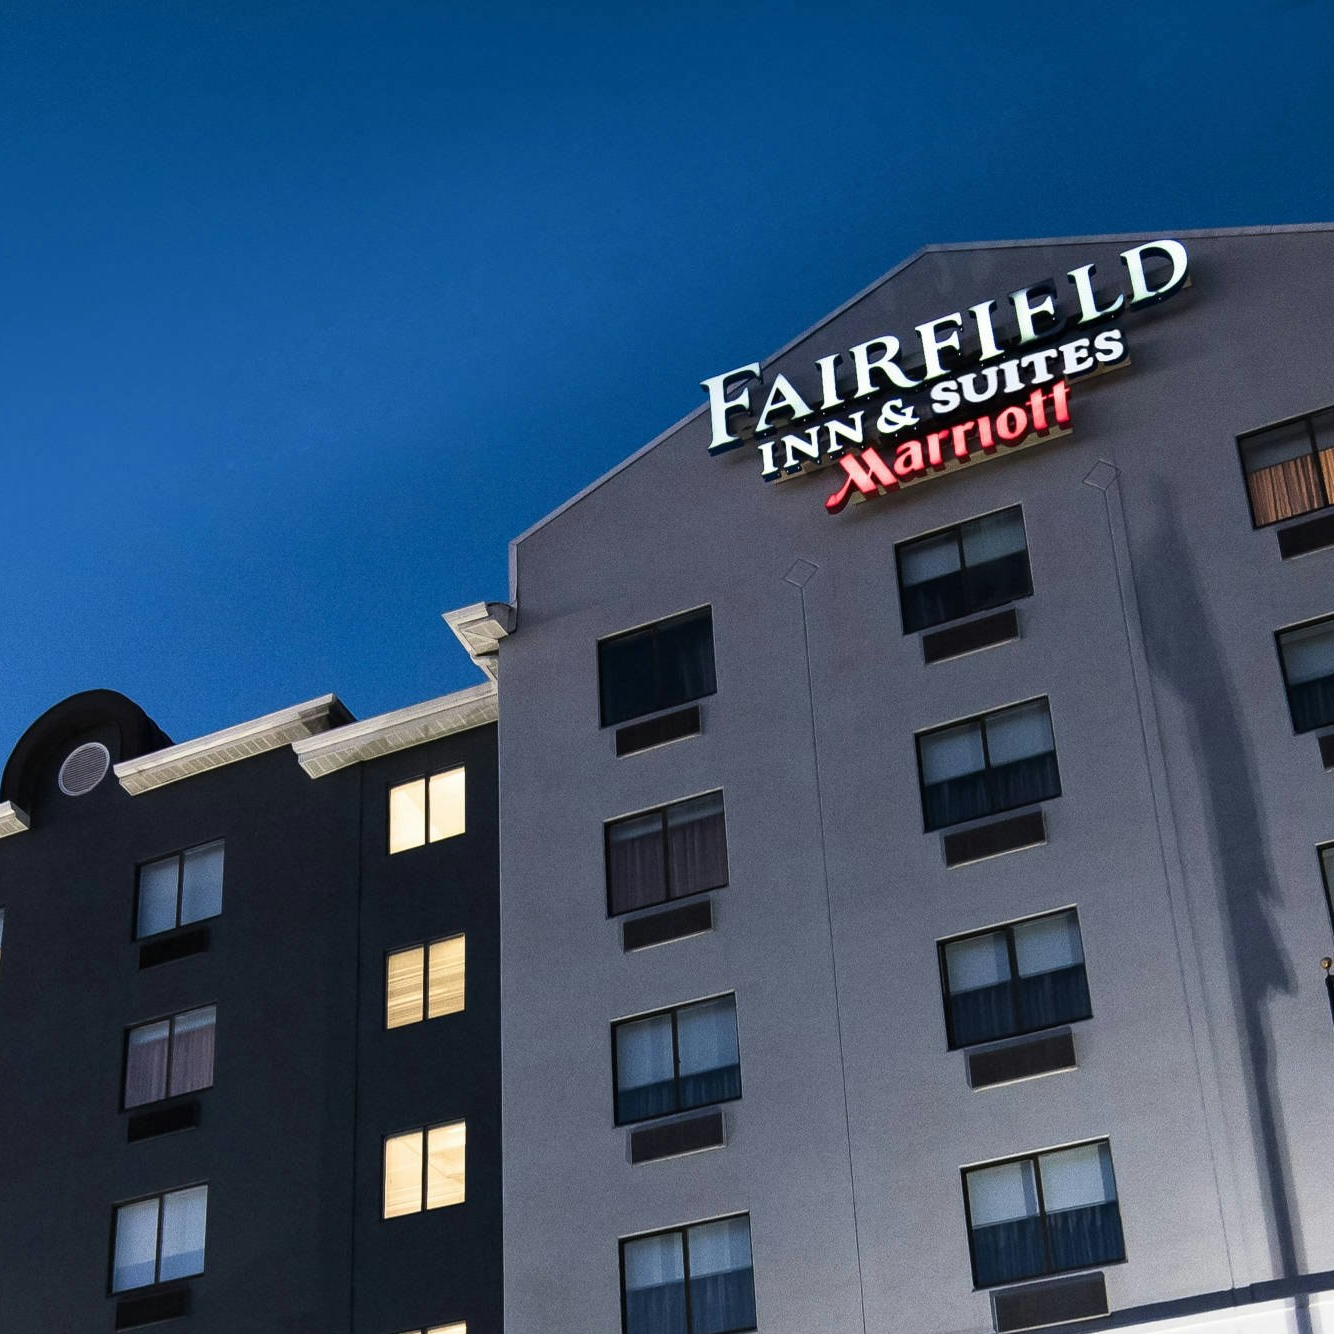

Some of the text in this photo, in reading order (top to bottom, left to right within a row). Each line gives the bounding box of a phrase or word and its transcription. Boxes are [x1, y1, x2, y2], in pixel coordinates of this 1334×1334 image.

[700, 239, 1189, 453] FAIRFIELD
[758, 328, 1125, 477] INN & SUITES
[825, 380, 1071, 513] Marriott
